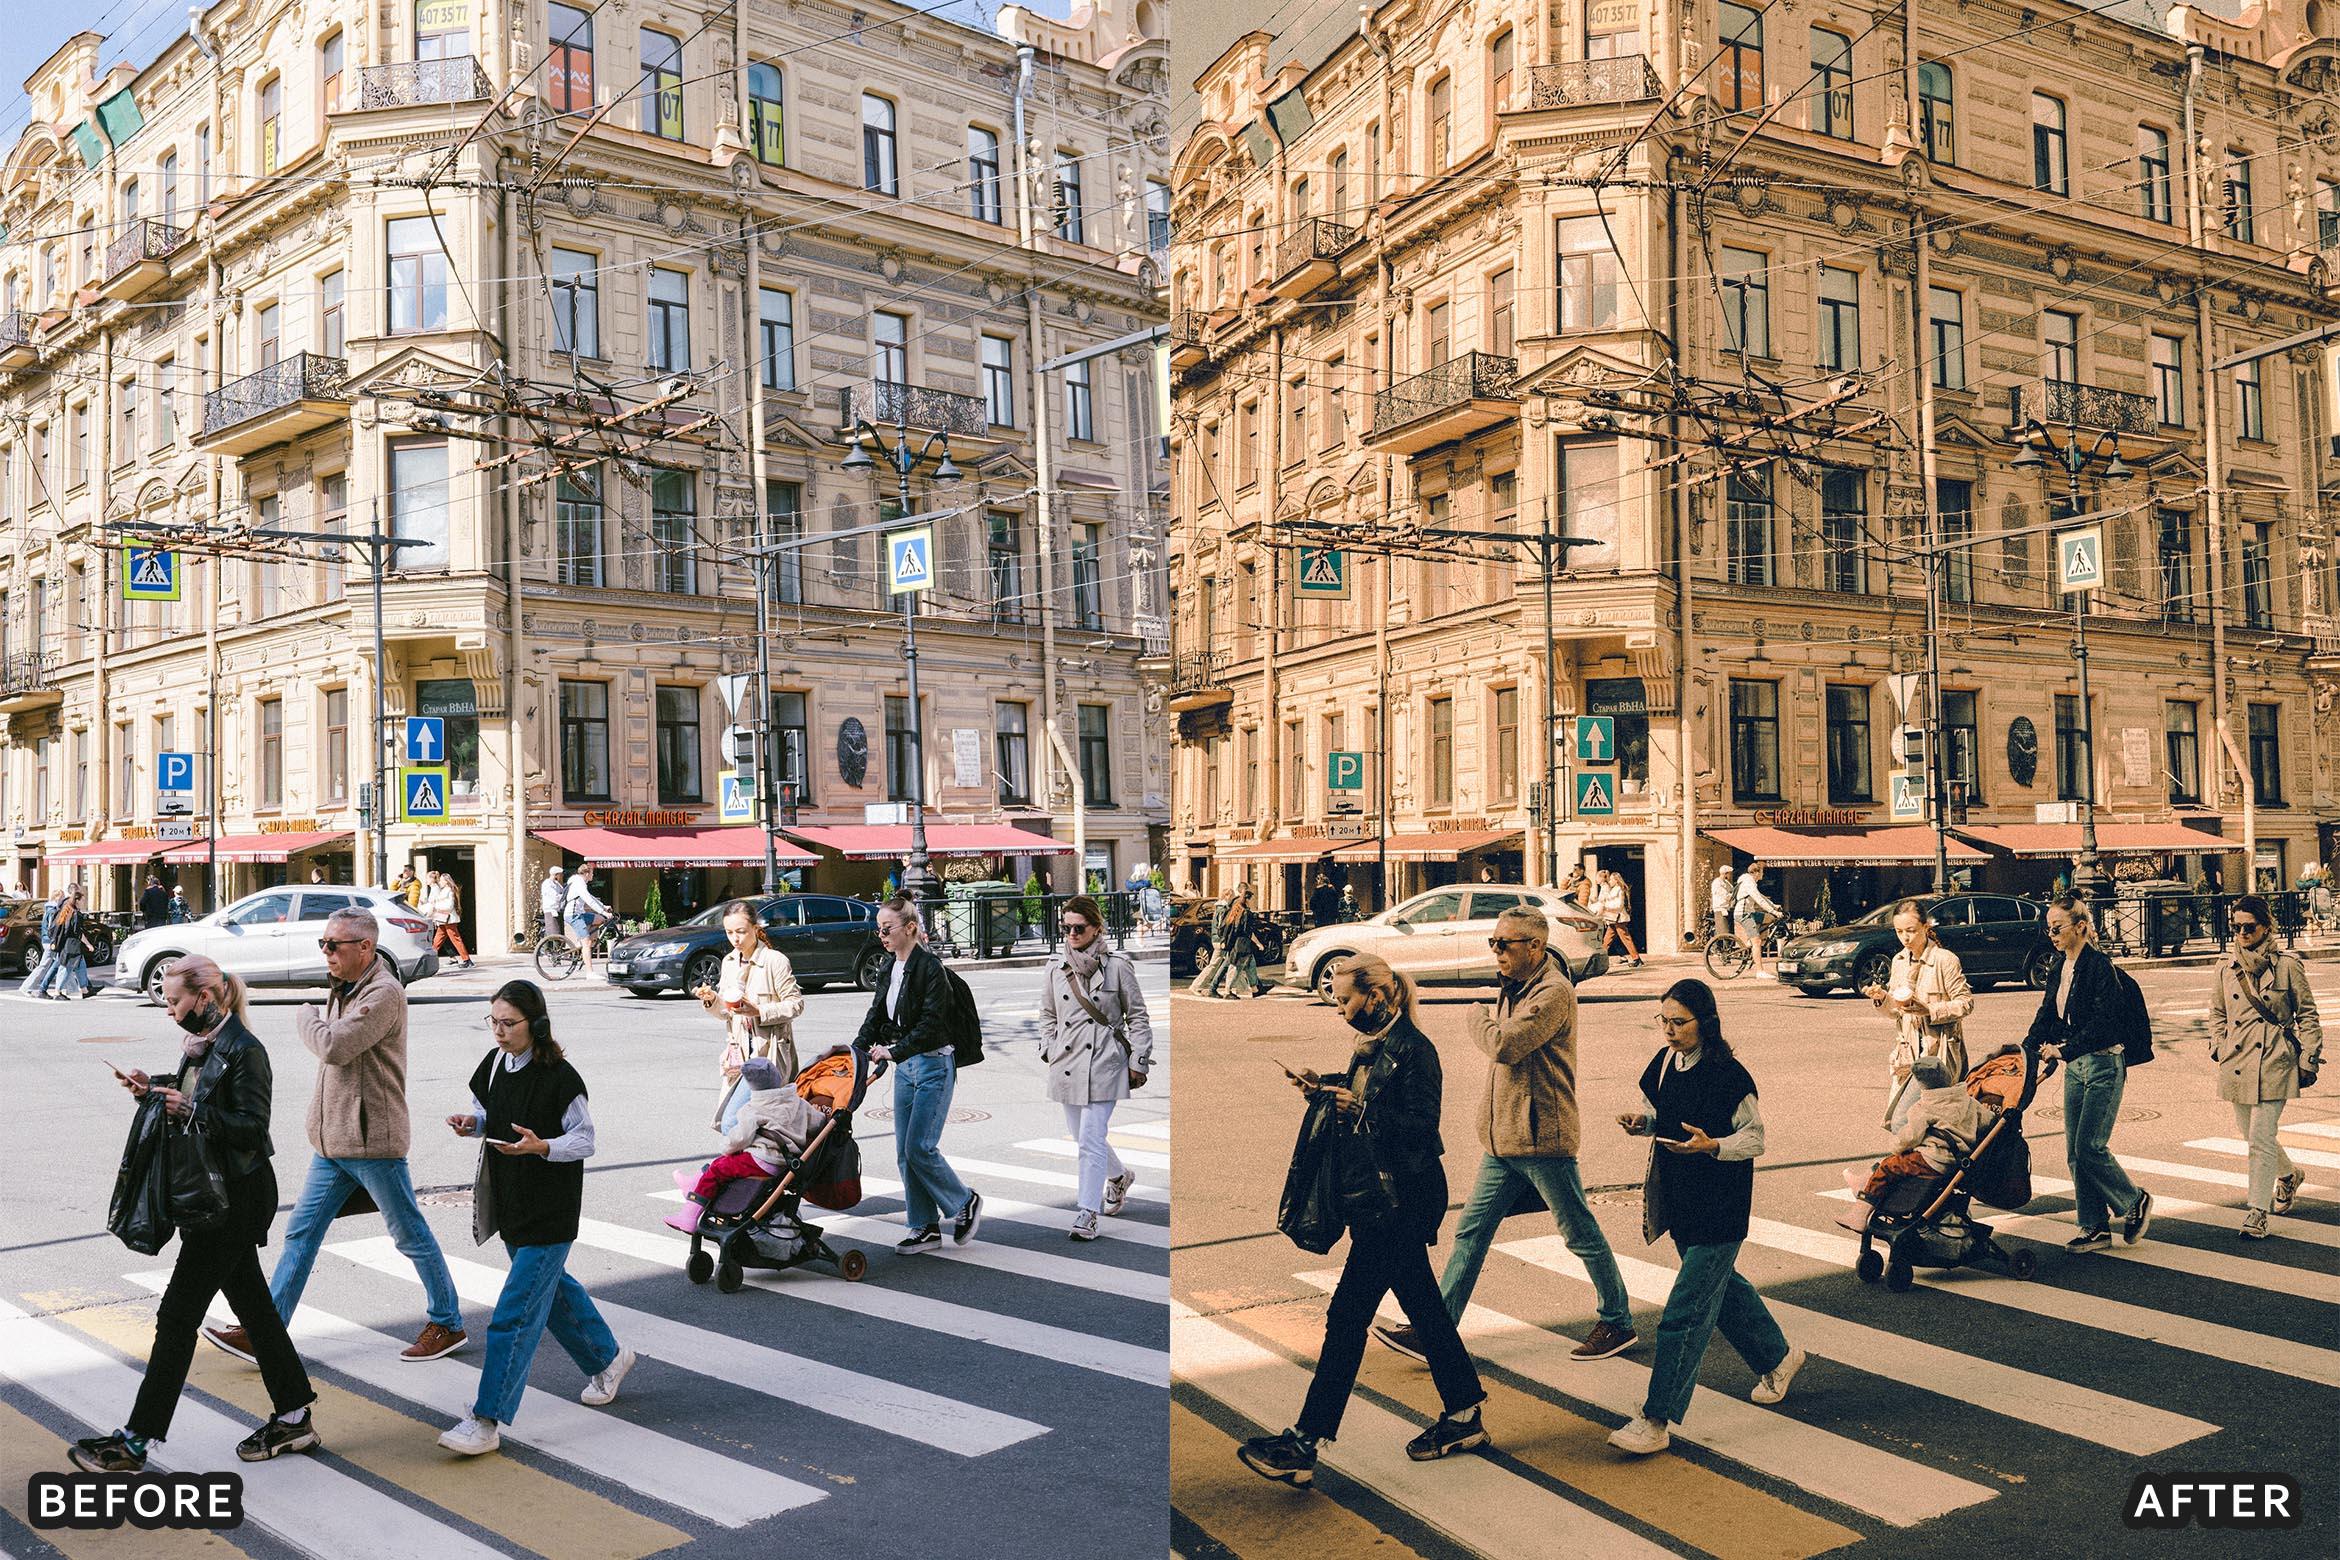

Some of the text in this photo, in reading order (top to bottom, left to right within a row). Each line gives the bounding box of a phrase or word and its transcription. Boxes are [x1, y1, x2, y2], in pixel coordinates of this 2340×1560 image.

[419, 5, 469, 24] 407 35 77
[662, 91, 680, 122] 07
[766, 119, 781, 149] 77
[168, 757, 187, 787] P
